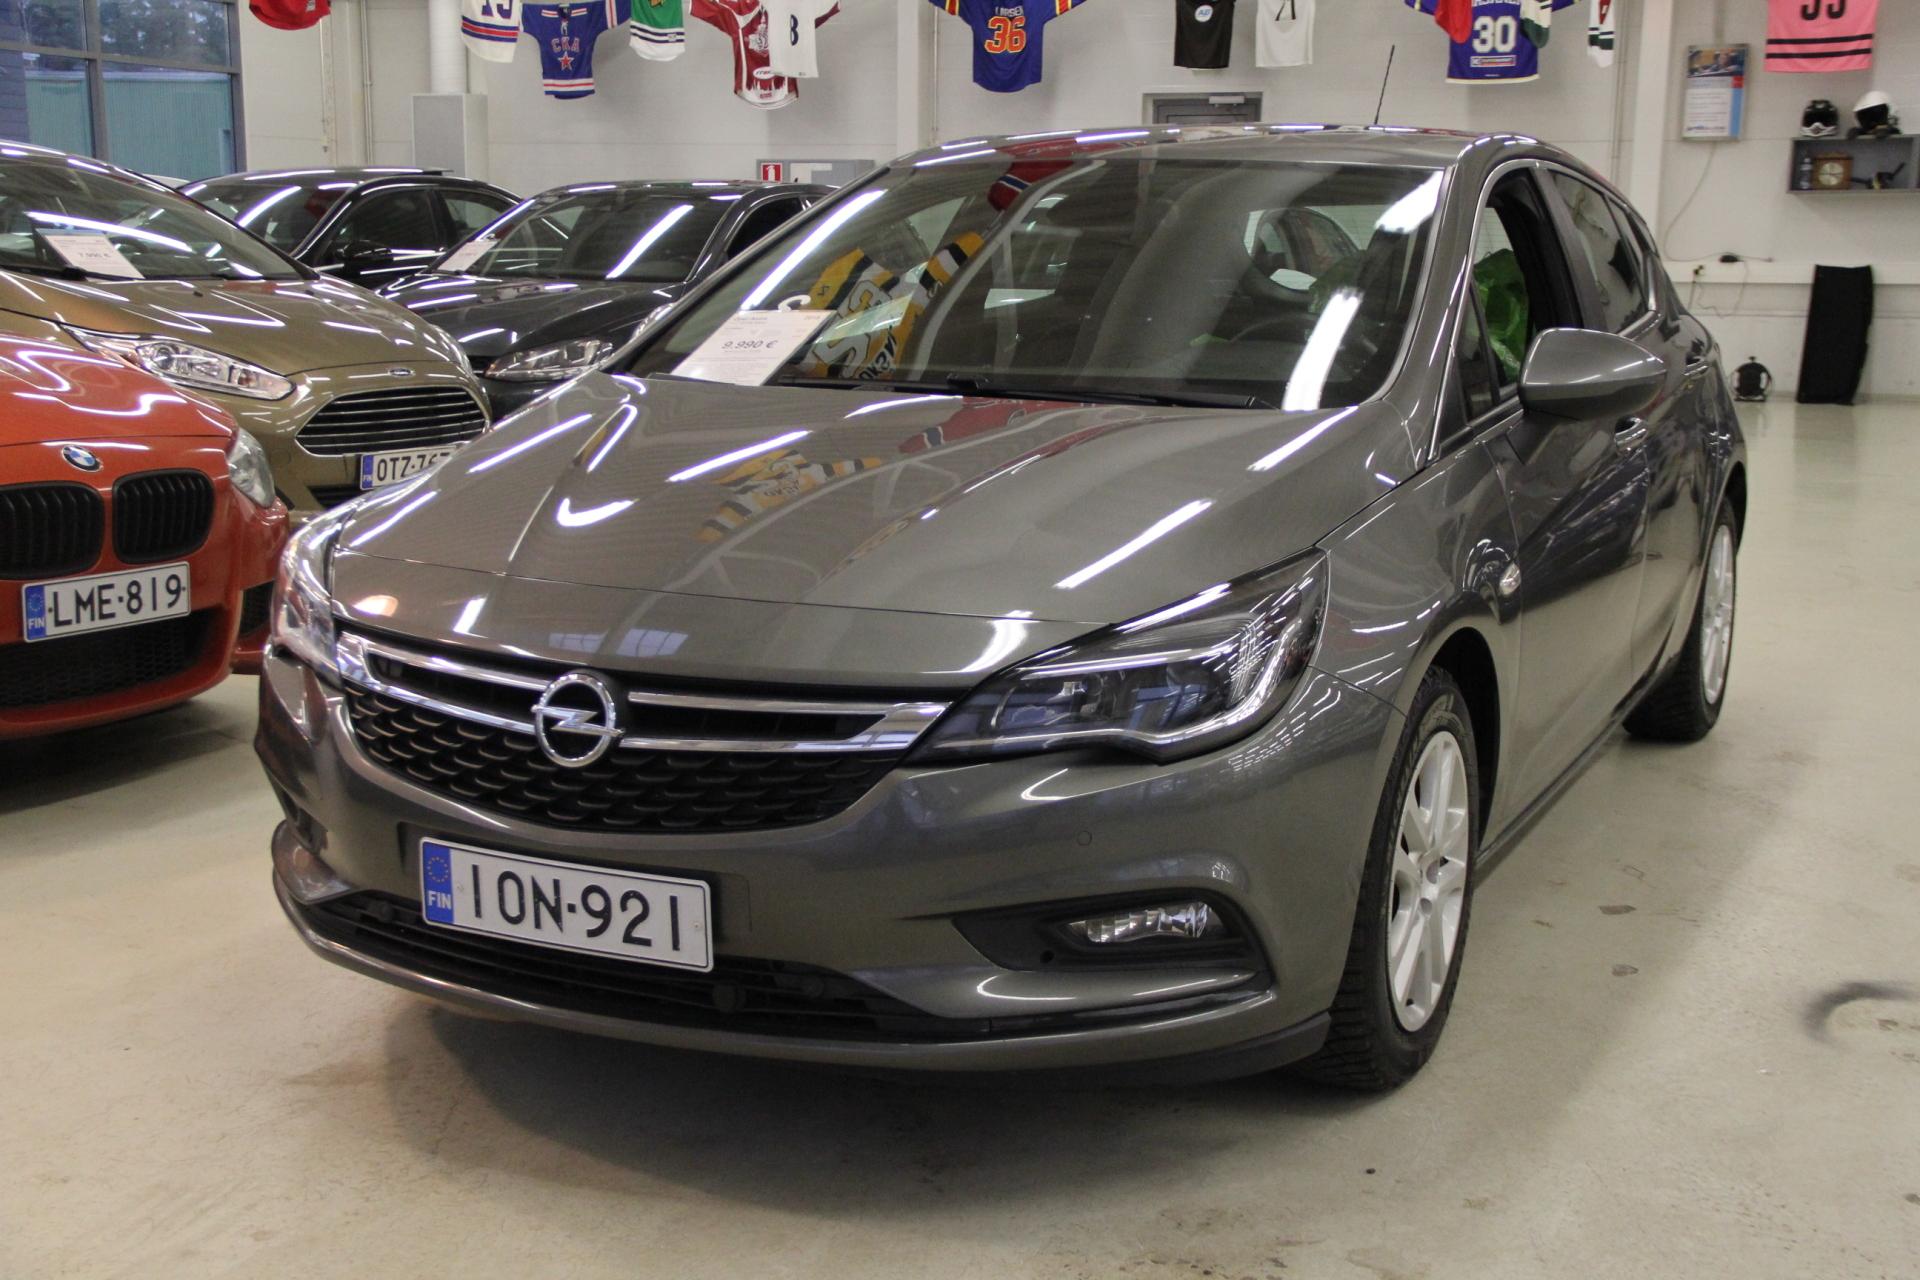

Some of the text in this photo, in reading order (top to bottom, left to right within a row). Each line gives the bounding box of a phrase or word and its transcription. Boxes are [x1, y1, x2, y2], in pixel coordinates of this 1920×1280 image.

[984, 16, 1026, 53] 36
[1472, 15, 1517, 53] 30
[377, 452, 450, 481] OTZ-7
[53, 573, 182, 628] LME-819
[28, 616, 45, 630] FIN
[427, 890, 452, 910] FIN
[471, 864, 681, 951] ION-921
